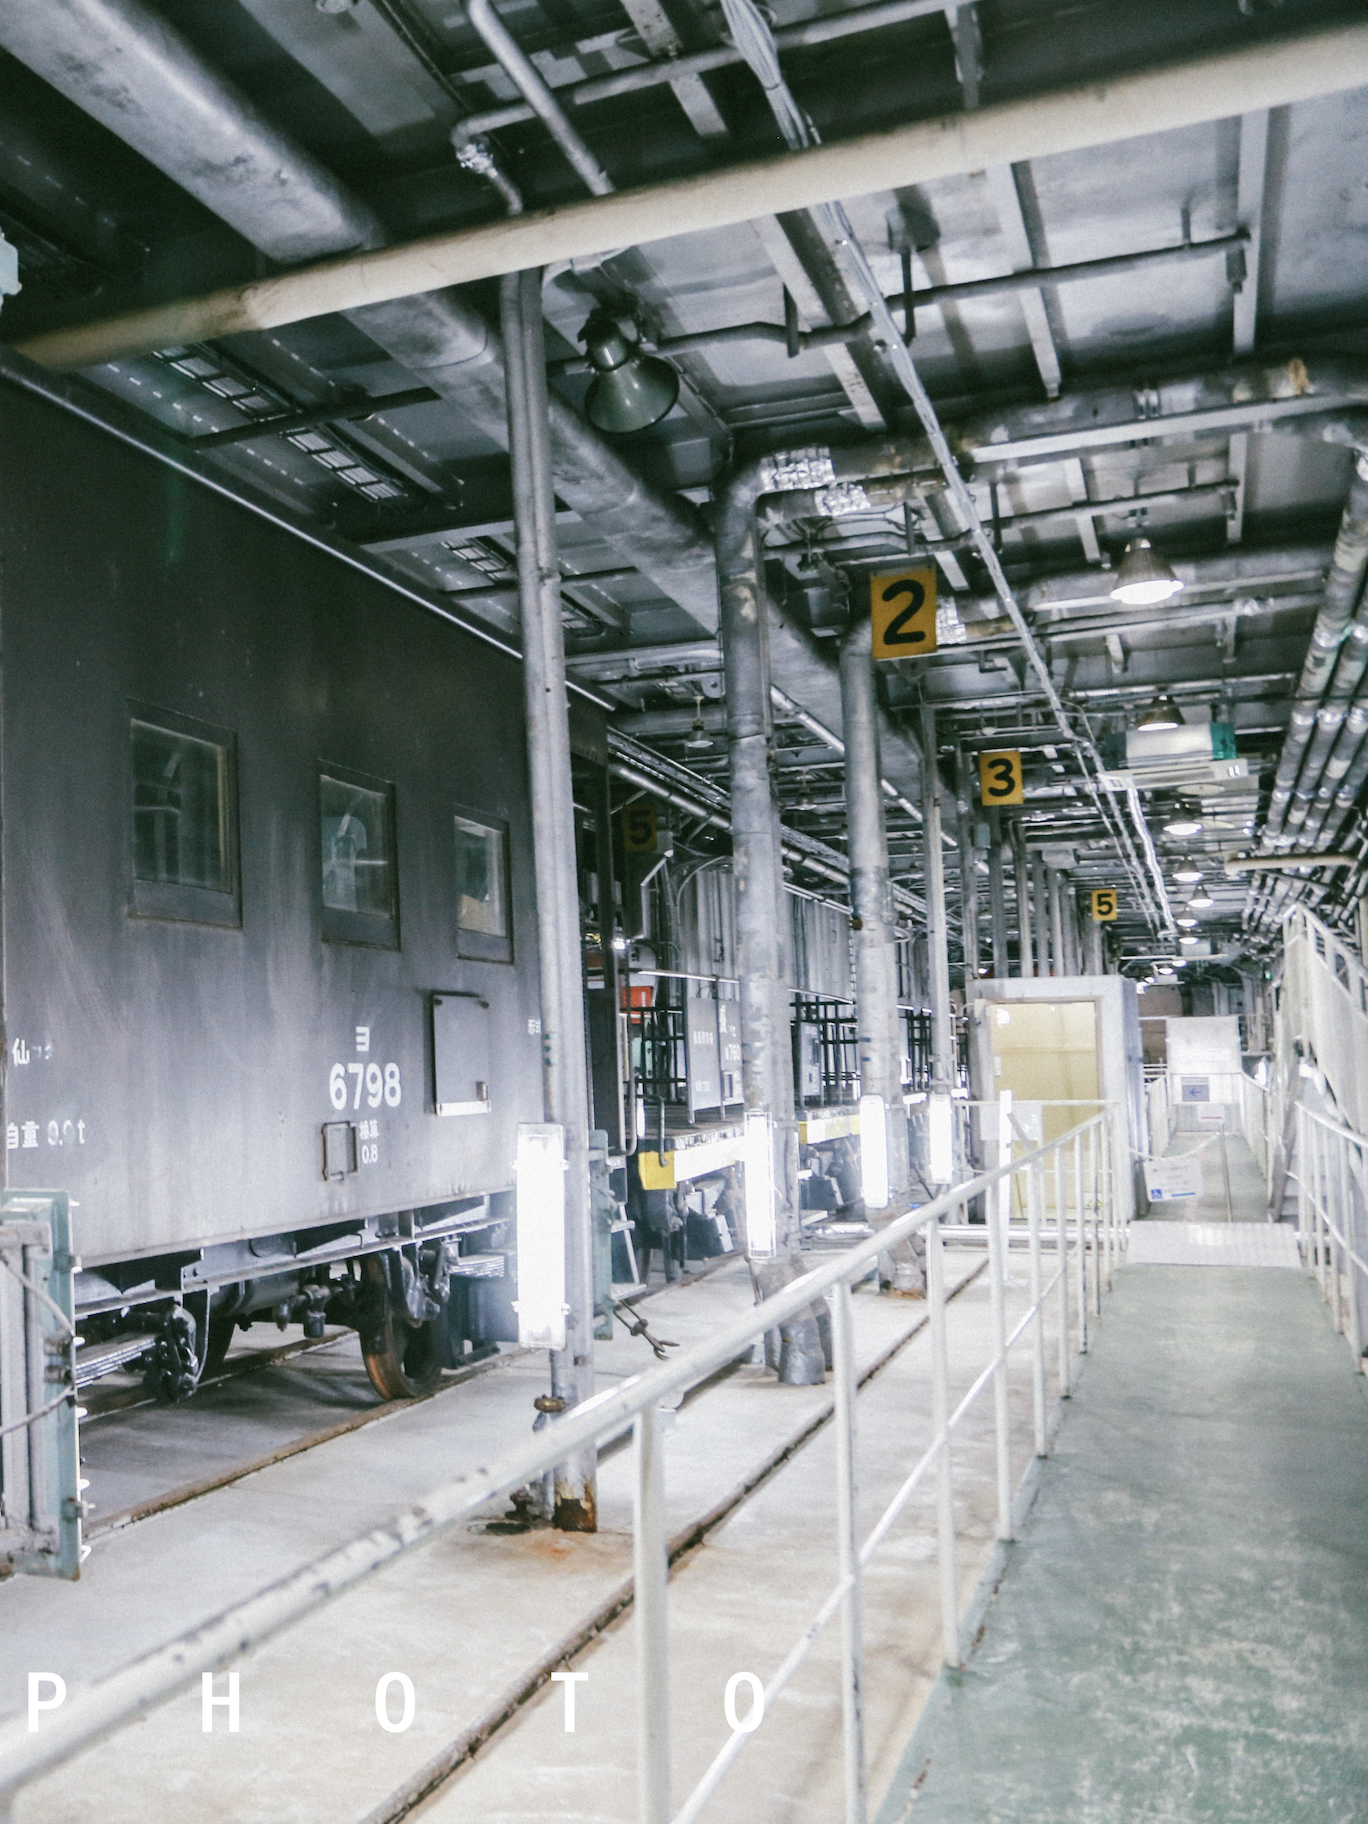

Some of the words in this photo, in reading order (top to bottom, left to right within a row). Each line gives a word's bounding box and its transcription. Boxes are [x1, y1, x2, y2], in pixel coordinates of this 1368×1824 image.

[882, 578, 926, 645] 2
[988, 758, 1016, 796] 3
[630, 810, 652, 845] 5
[1097, 893, 1113, 916] 5
[355, 1025, 370, 1052] ヨ
[329, 1062, 402, 1111] 6798
[7, 1120, 40, 1150] 自重
[361, 1143, 379, 1165] 0.8
